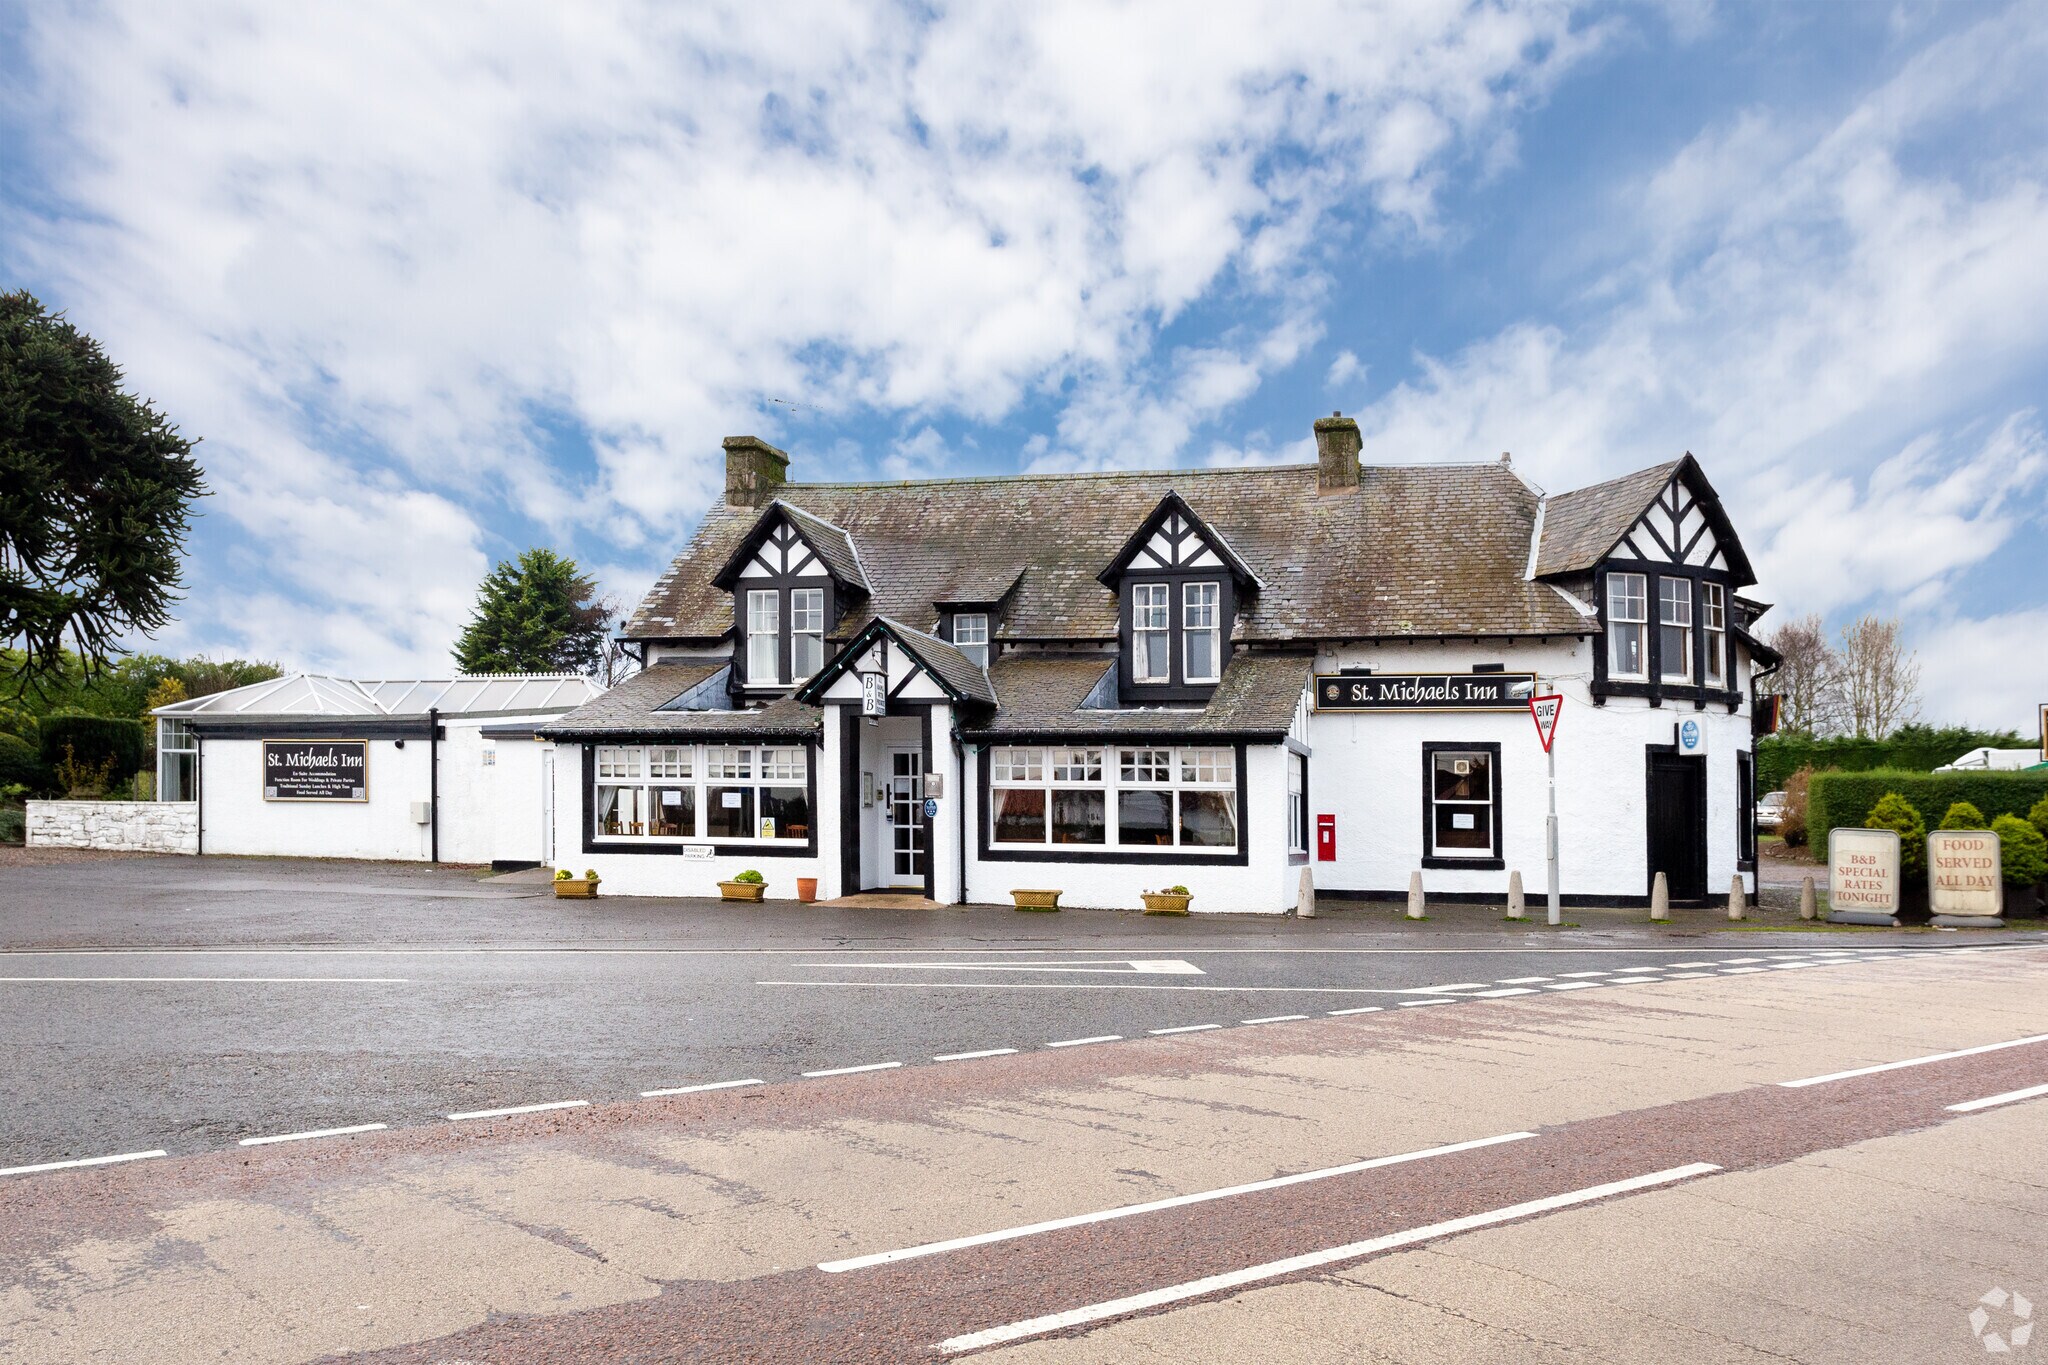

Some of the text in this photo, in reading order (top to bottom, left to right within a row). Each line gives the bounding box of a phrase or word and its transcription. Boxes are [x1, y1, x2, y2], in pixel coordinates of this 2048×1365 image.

[1351, 676, 1498, 704] St. Michaels Inn
[1536, 704, 1554, 716] GIVE
[1540, 720, 1552, 730] WAY
[268, 747, 363, 769] St. Michaels Inn
[1943, 839, 1984, 851] FOOD
[1850, 854, 1876, 865] B&B
[1936, 857, 1993, 869] SERVED
[1838, 866, 1889, 878] SPECIAL
[1844, 880, 1883, 890] RATES
[1935, 875, 1995, 887] ALL DAY
[1836, 891, 1891, 903] TONIGHT
